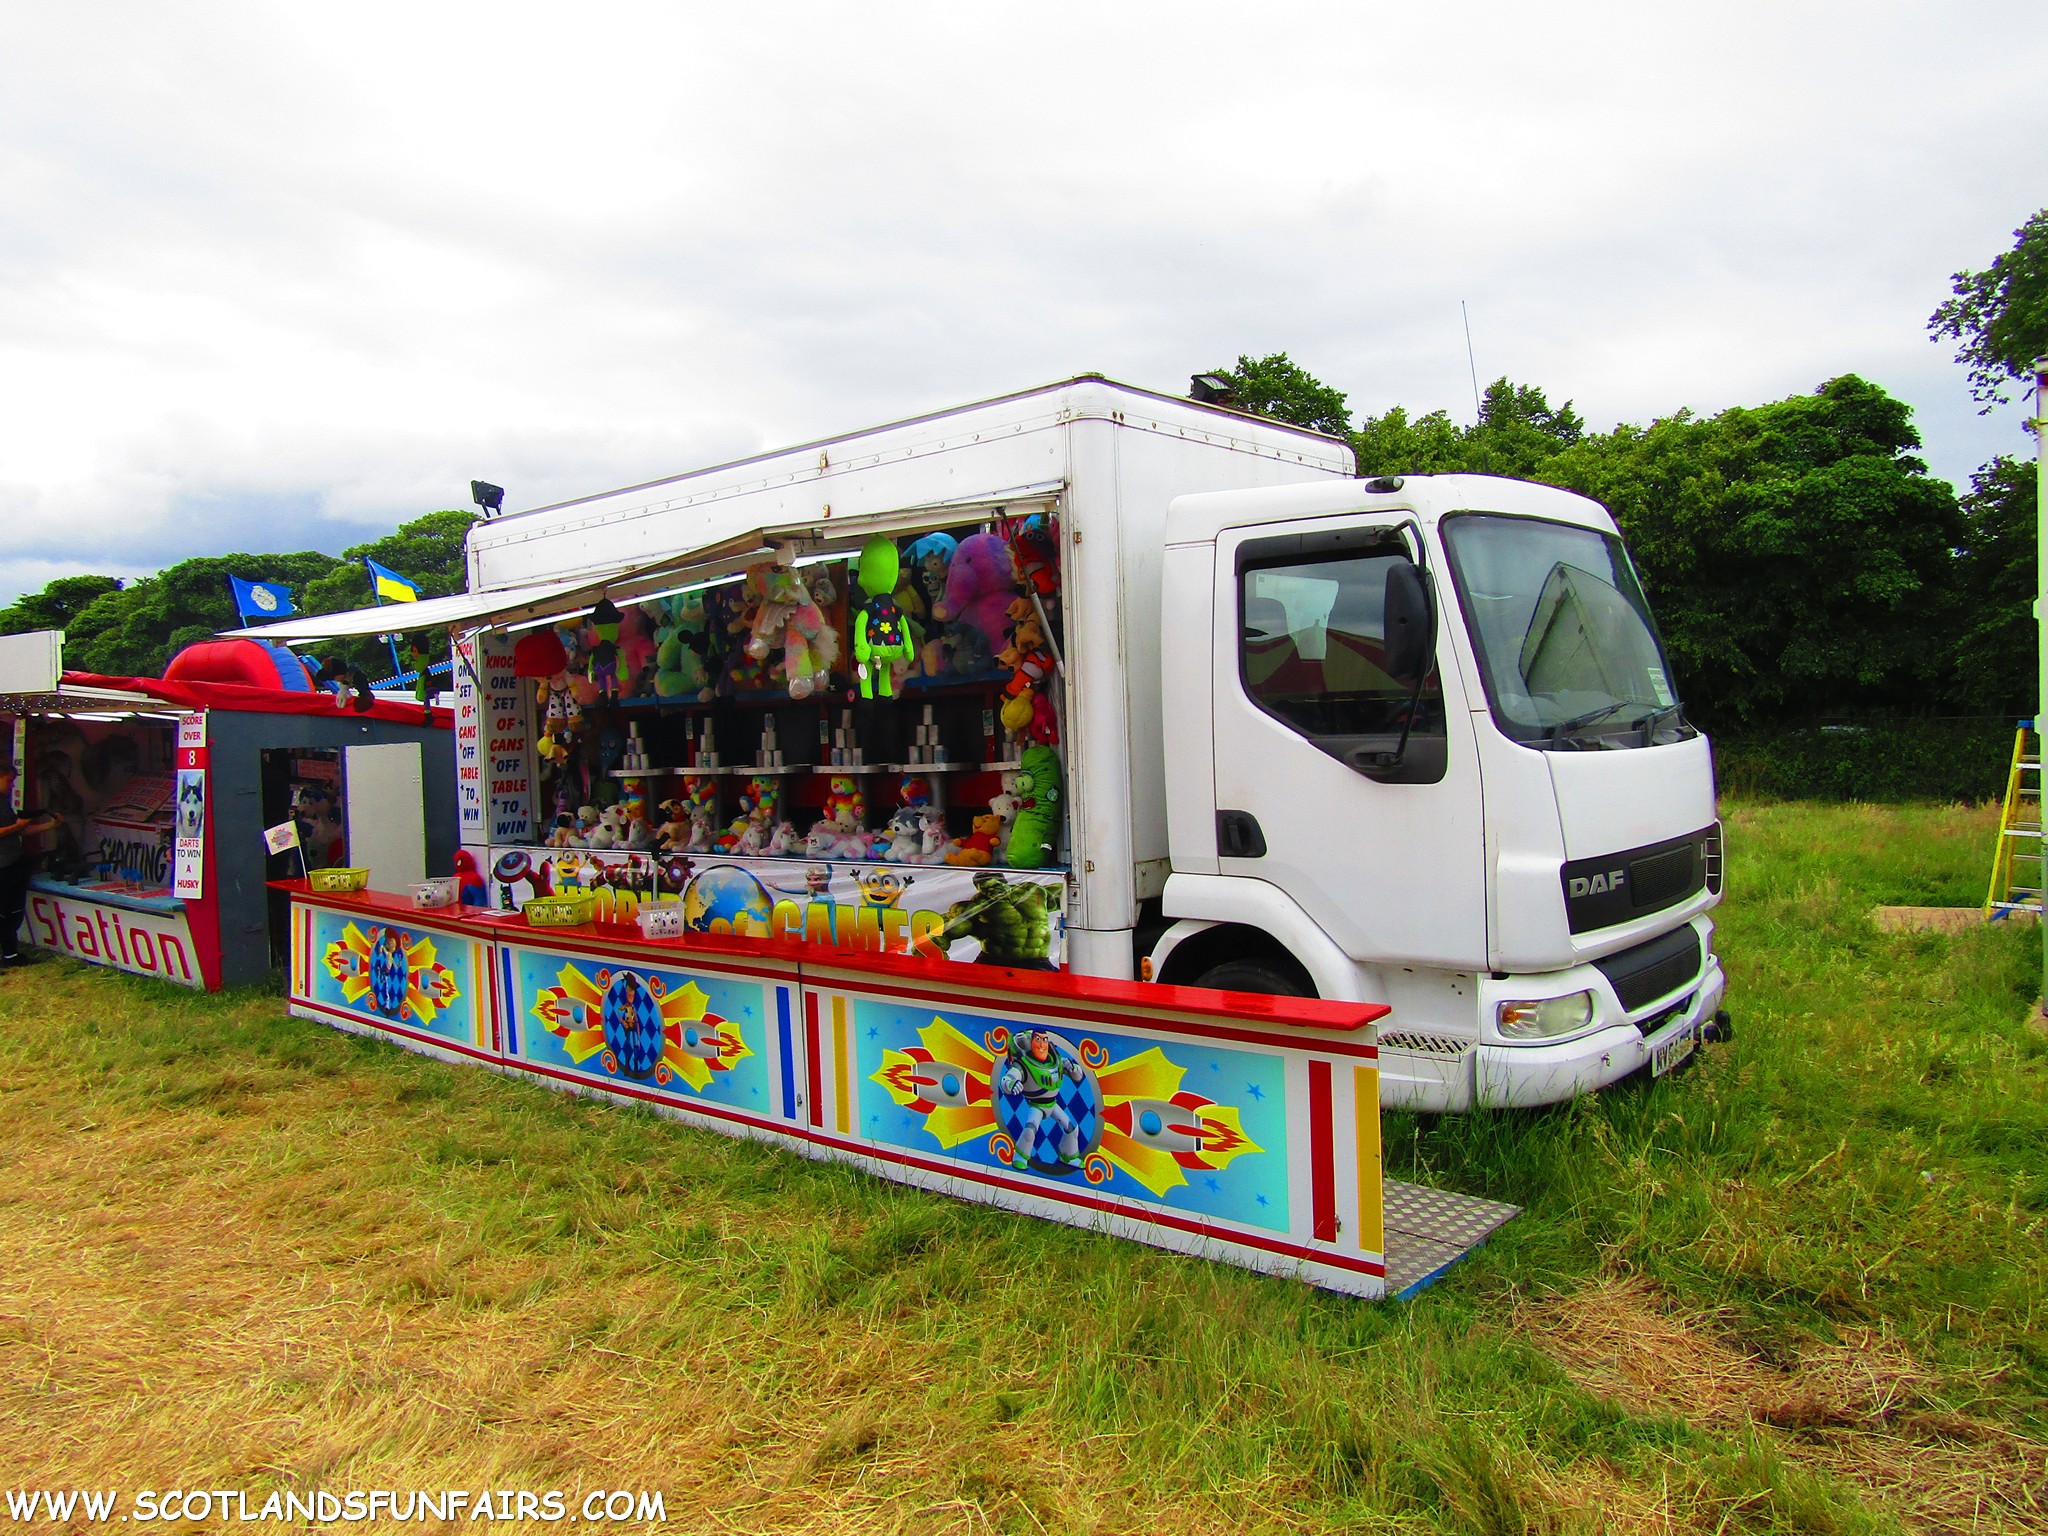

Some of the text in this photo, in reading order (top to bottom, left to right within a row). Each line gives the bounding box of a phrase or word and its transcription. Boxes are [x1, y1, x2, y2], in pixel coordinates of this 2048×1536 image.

[491, 676, 517, 689] ONE
[460, 685, 472, 698] SET
[493, 697, 517, 710] SET
[462, 706, 471, 718] OF
[182, 716, 203, 725] SCORE
[497, 718, 516, 730] OF
[184, 731, 201, 740] OVER
[459, 726, 476, 739] CANS
[490, 738, 524, 752] CANS
[189, 750, 196, 766] 8
[463, 747, 475, 759] OFF
[497, 759, 520, 773] OFF
[461, 767, 478, 780] TABLE
[492, 779, 527, 794] TABLE
[466, 788, 475, 800] TO
[502, 801, 519, 814] TO
[464, 808, 479, 821] WIN
[497, 821, 526, 835] WIN
[180, 839, 199, 848] DARTS
[177, 849, 201, 858] TO WIN
[186, 864, 192, 873] A
[177, 879, 199, 889] HUSKY
[1569, 870, 1624, 898] DAF
[773, 899, 945, 960] GAMES
[32, 897, 193, 980] Station
